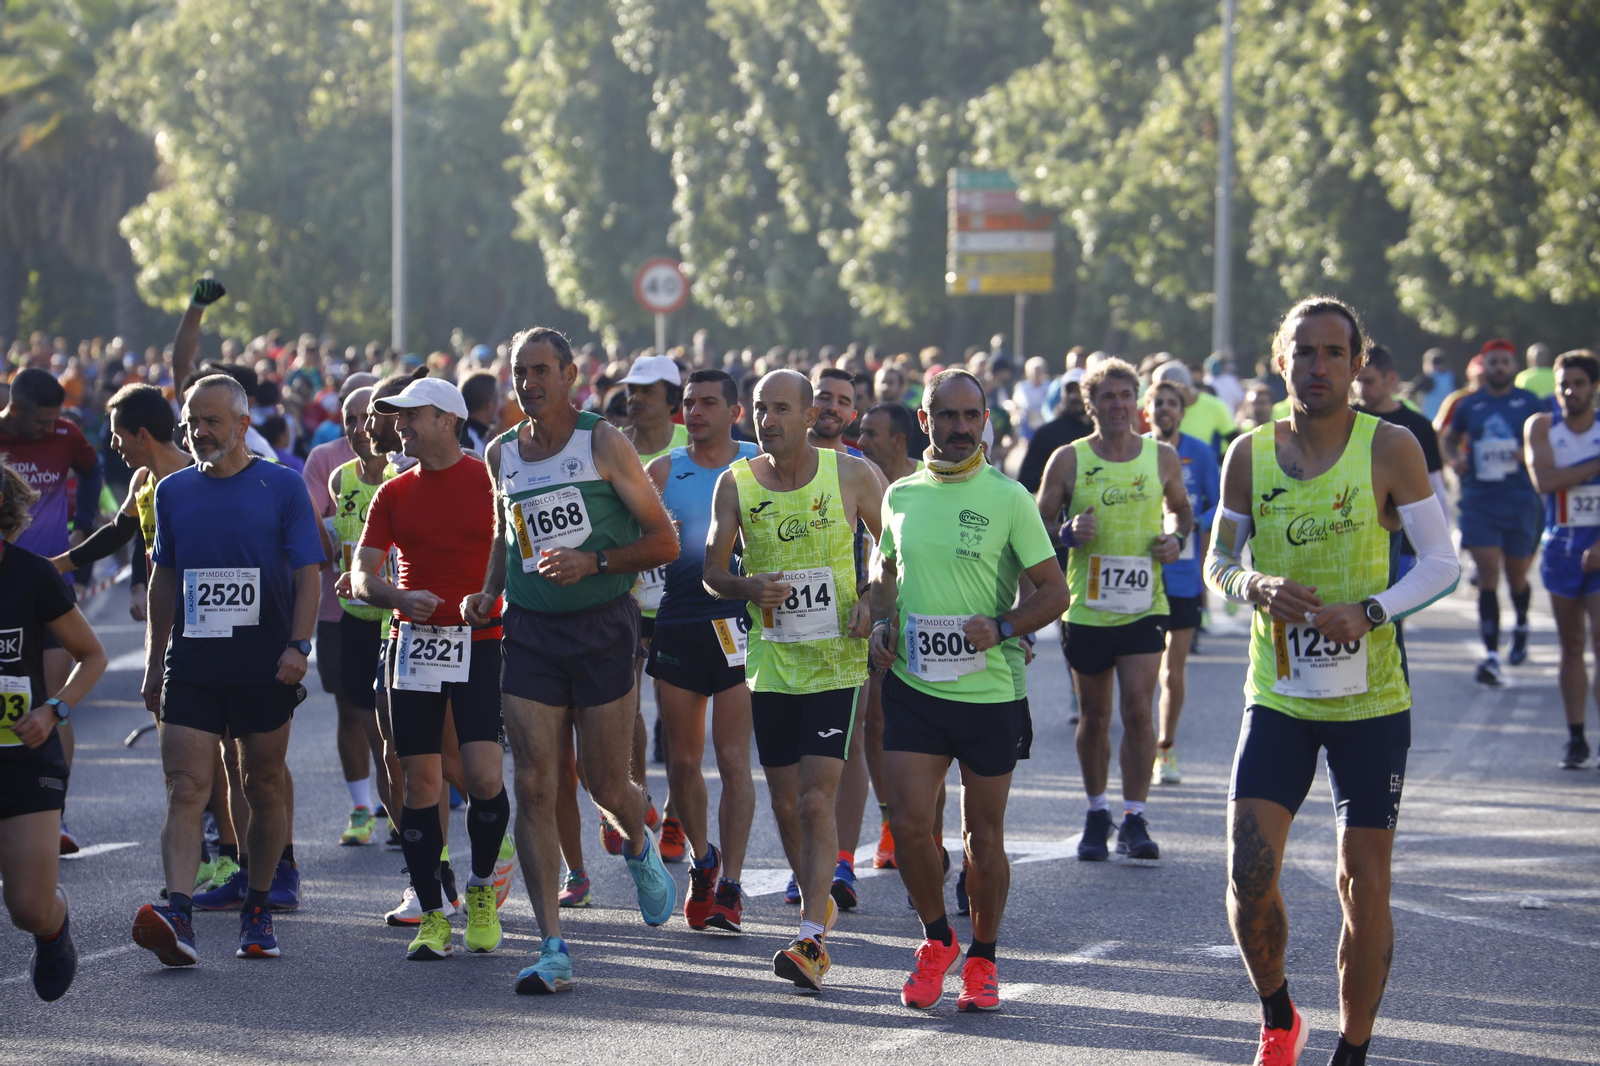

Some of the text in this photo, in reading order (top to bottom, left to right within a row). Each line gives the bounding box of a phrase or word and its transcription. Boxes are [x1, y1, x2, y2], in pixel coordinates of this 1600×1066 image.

[21, 469, 60, 483] RATÓN
[527, 495, 555, 508] IMDECO
[527, 502, 583, 537] 1668
[1102, 568, 1148, 588] 1740
[198, 583, 256, 606] 2520
[778, 583, 831, 610] 814
[720, 626, 730, 645] CAJÓN
[400, 642, 408, 664] CAJÓN
[409, 638, 464, 662] 2521
